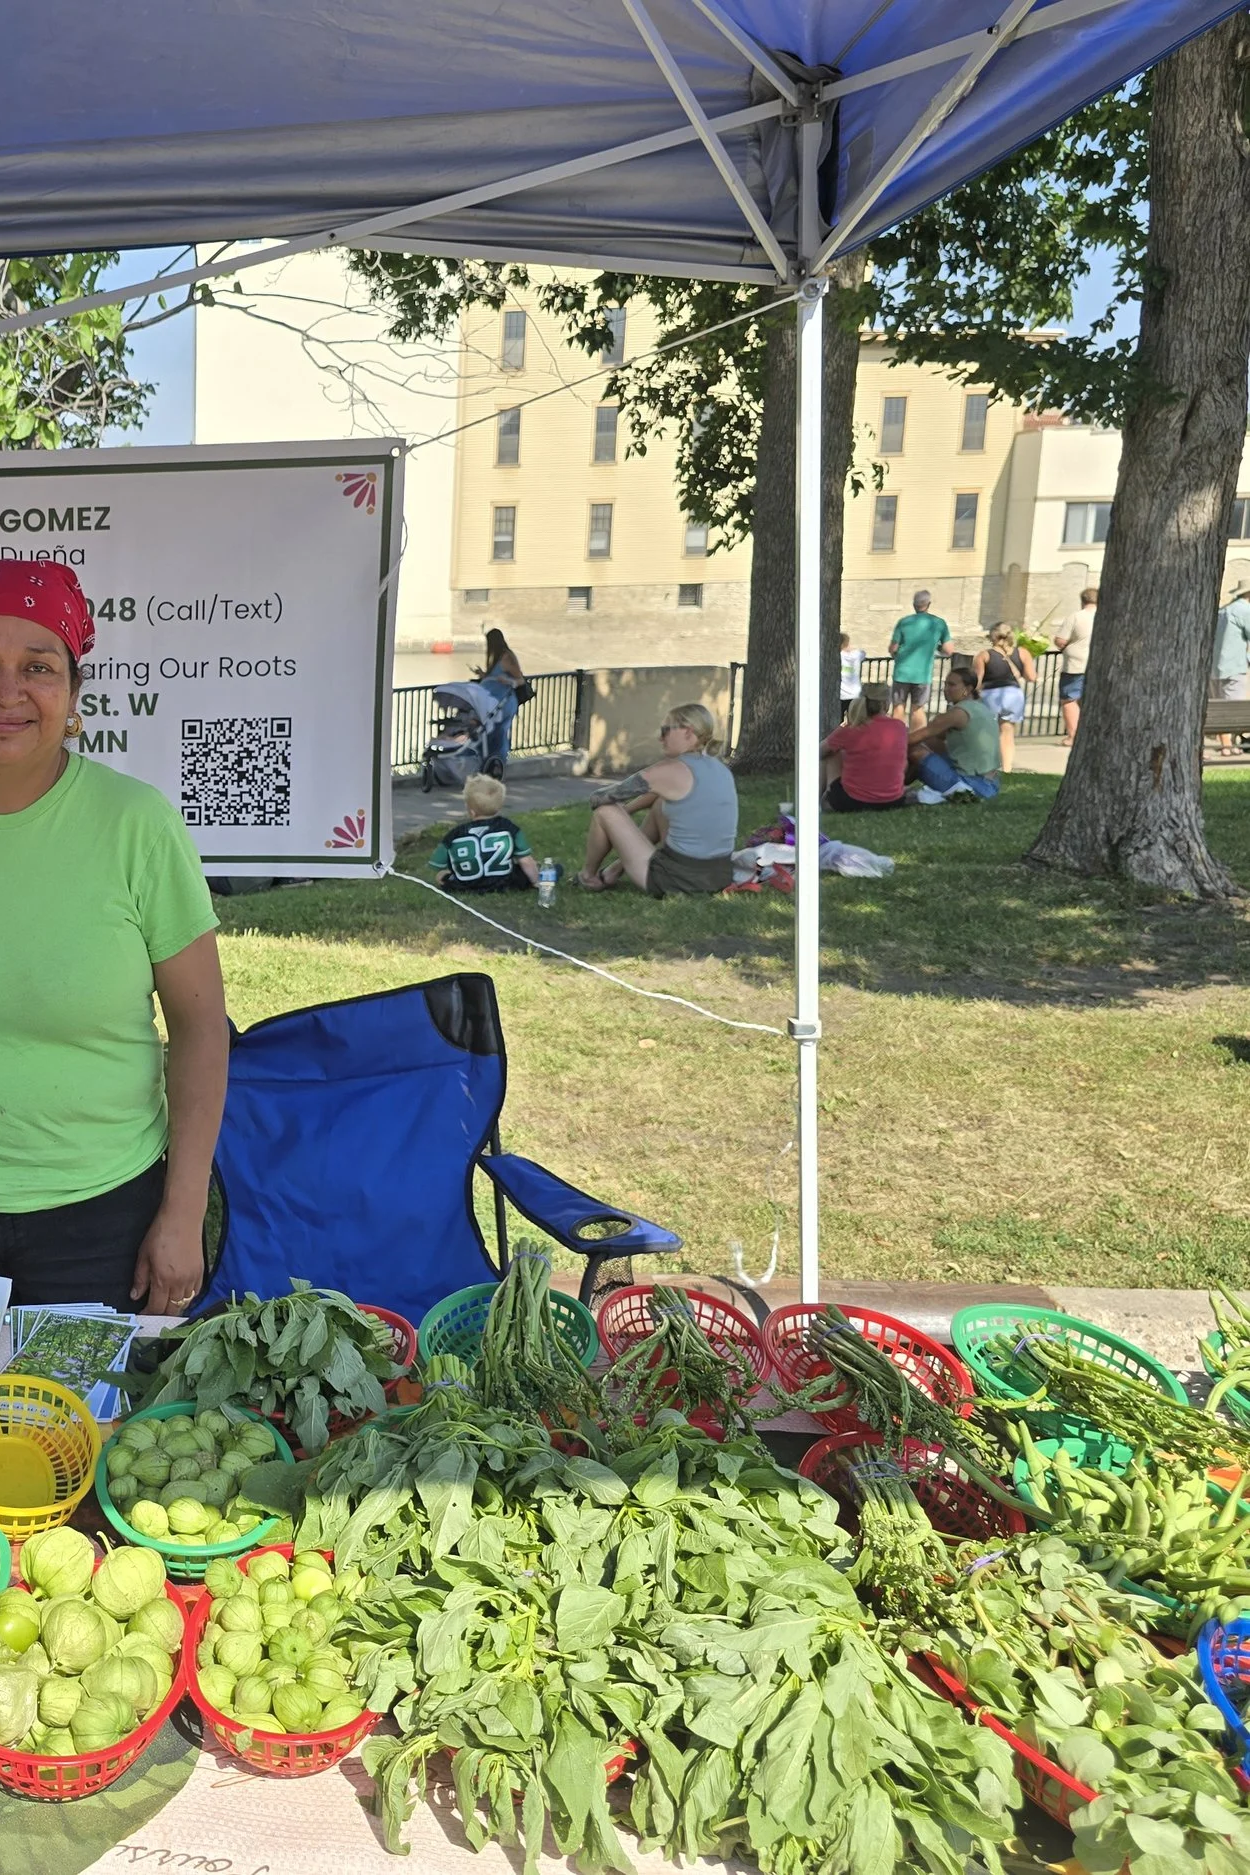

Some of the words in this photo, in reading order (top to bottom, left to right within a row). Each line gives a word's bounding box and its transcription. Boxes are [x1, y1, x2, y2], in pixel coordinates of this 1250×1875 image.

[146, 592, 283, 627] (Call/Text)
[159, 657, 210, 679] Our
[219, 655, 297, 678] Roots
[80, 692, 119, 717] St.
[128, 692, 160, 716] W
[78, 729, 128, 753] MN
[448, 831, 514, 881] 82
